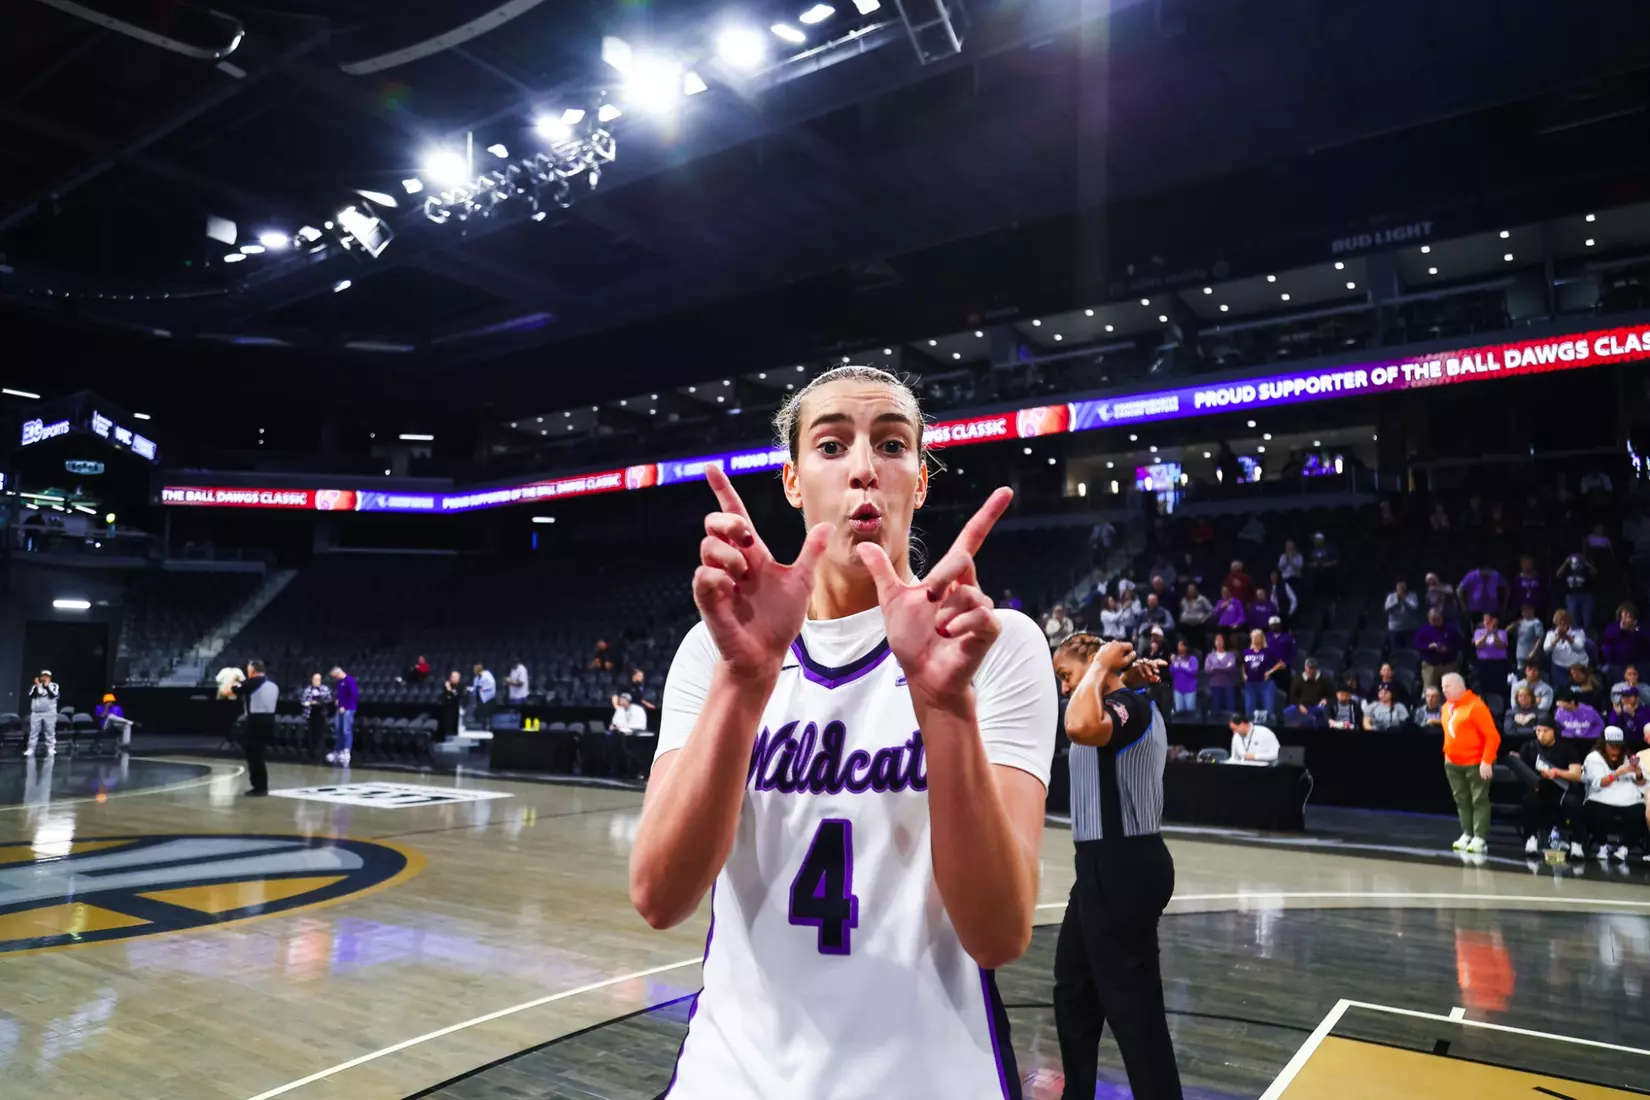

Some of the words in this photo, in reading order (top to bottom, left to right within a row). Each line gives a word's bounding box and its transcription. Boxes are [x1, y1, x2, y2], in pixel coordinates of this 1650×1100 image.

[1332, 234, 1373, 252] BUD
[1374, 221, 1434, 245] LIGHT
[1193, 385, 1257, 410] PROUD
[1258, 370, 1368, 402] SUPPORTER
[1371, 366, 1398, 386] OF
[1400, 360, 1442, 382] THE
[1446, 352, 1501, 377] BALL
[1504, 338, 1589, 369] DAWGS
[952, 418, 1007, 440] CLASSIC
[162, 489, 184, 502] THE
[186, 490, 215, 502] BALL
[216, 490, 259, 504] DAWGS
[260, 492, 307, 505] CLASSIC
[788, 818, 858, 955] 4
